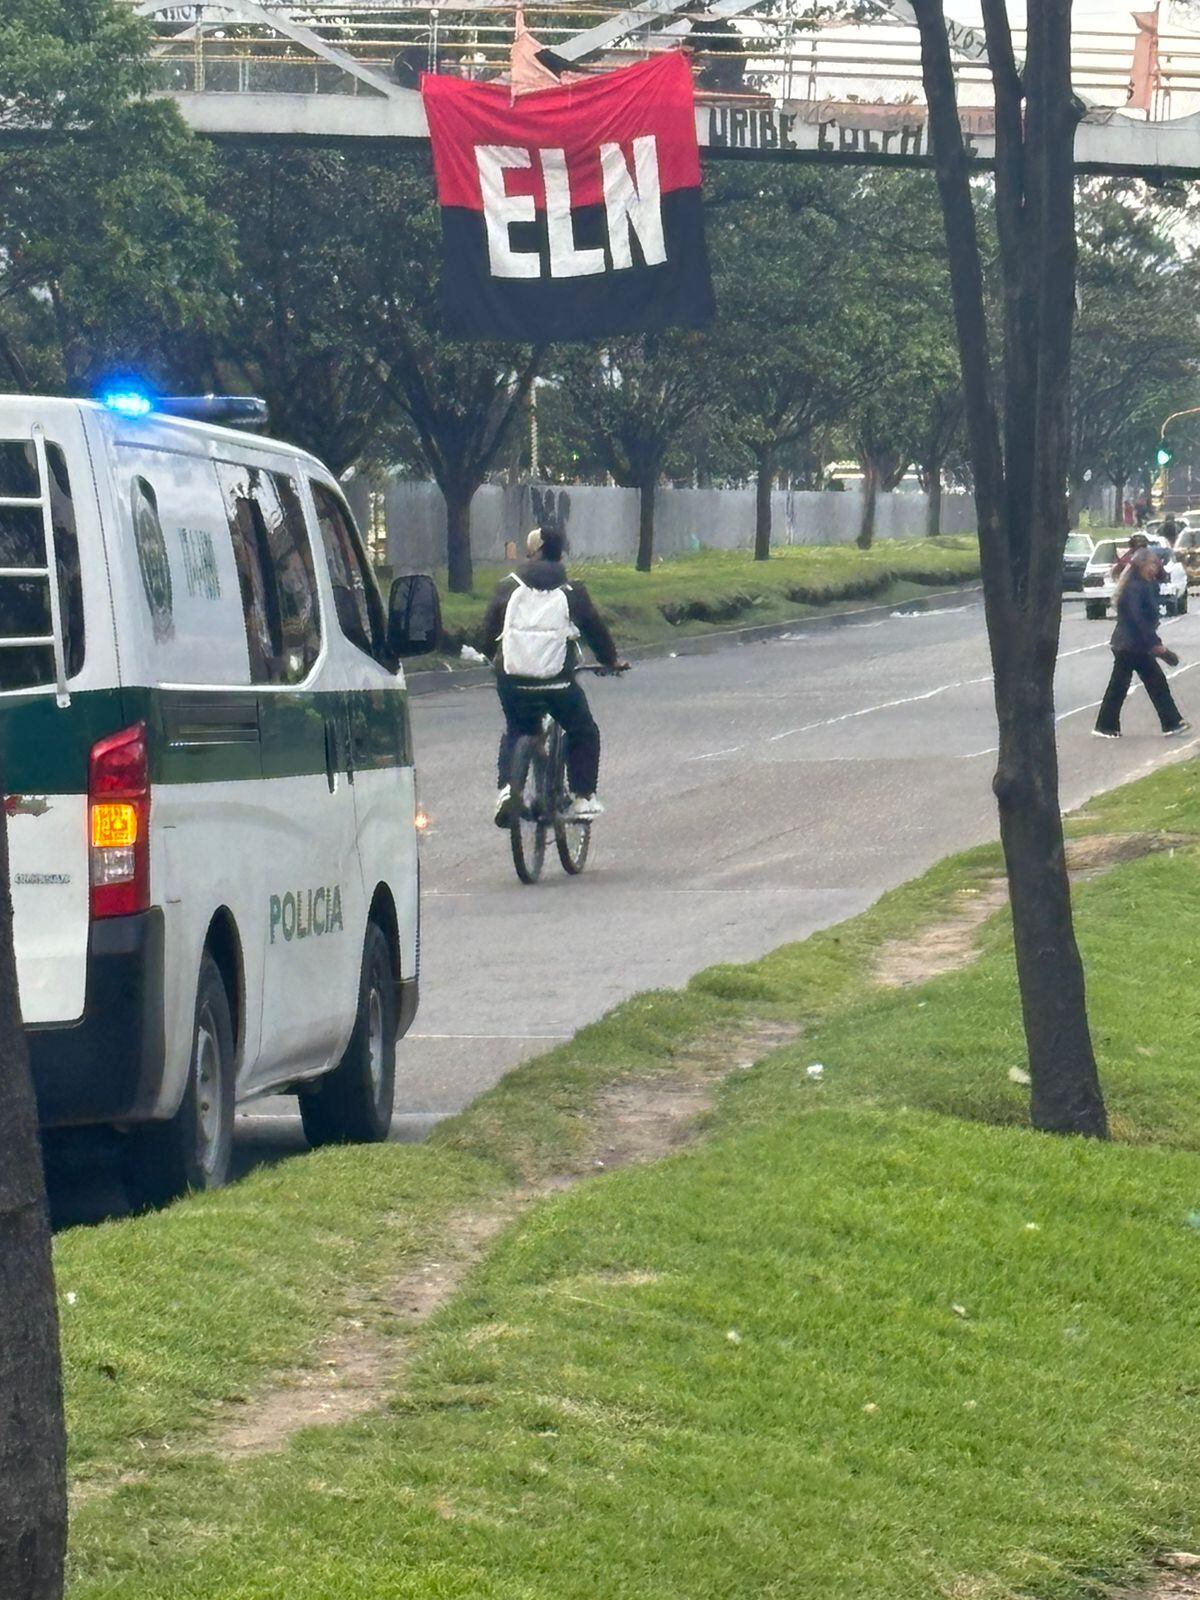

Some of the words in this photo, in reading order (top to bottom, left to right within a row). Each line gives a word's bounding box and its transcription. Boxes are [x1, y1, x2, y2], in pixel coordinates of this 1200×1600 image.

[708, 107, 797, 149] URIBE
[474, 135, 667, 278] ELN
[269, 885, 343, 944] POLICIA
